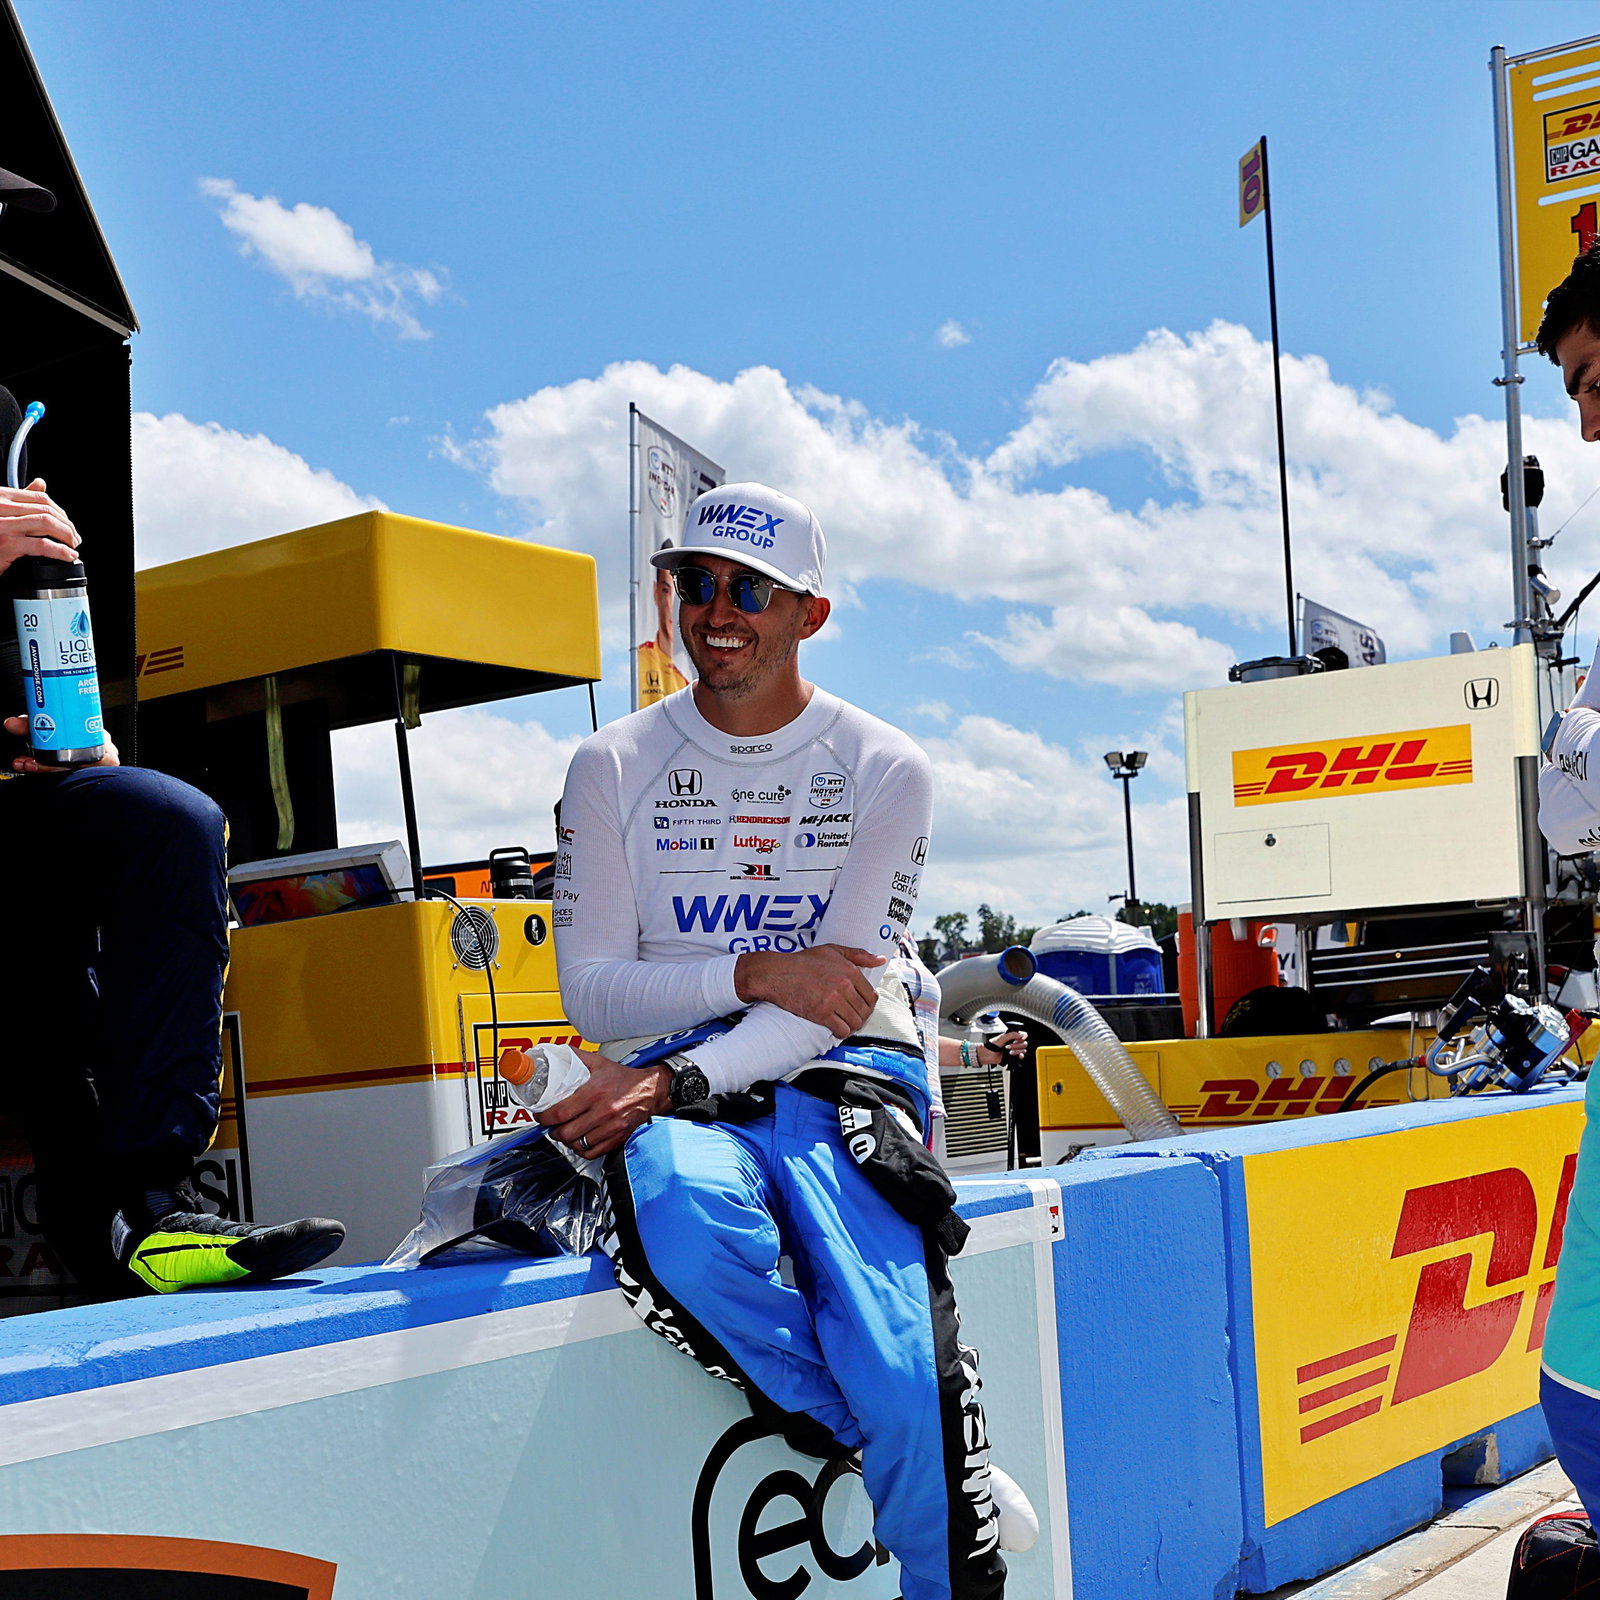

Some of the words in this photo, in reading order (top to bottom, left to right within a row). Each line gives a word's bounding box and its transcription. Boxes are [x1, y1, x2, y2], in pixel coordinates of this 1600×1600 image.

[712, 525, 774, 549] GROUP
[23, 613, 39, 627] 20
[730, 743, 773, 754] sparco
[1264, 739, 1439, 795] DHL
[758, 789, 786, 801] cure
[655, 800, 718, 809] HONDA
[735, 816, 790, 824] HENDRICKSON
[656, 838, 697, 850] Mobil
[733, 835, 776, 848] Luther
[816, 839, 849, 848] Rentals
[894, 871, 911, 885] FLEET
[892, 880, 908, 893] COST
[563, 890, 580, 902] Pay
[1198, 1075, 1368, 1117] DHL
